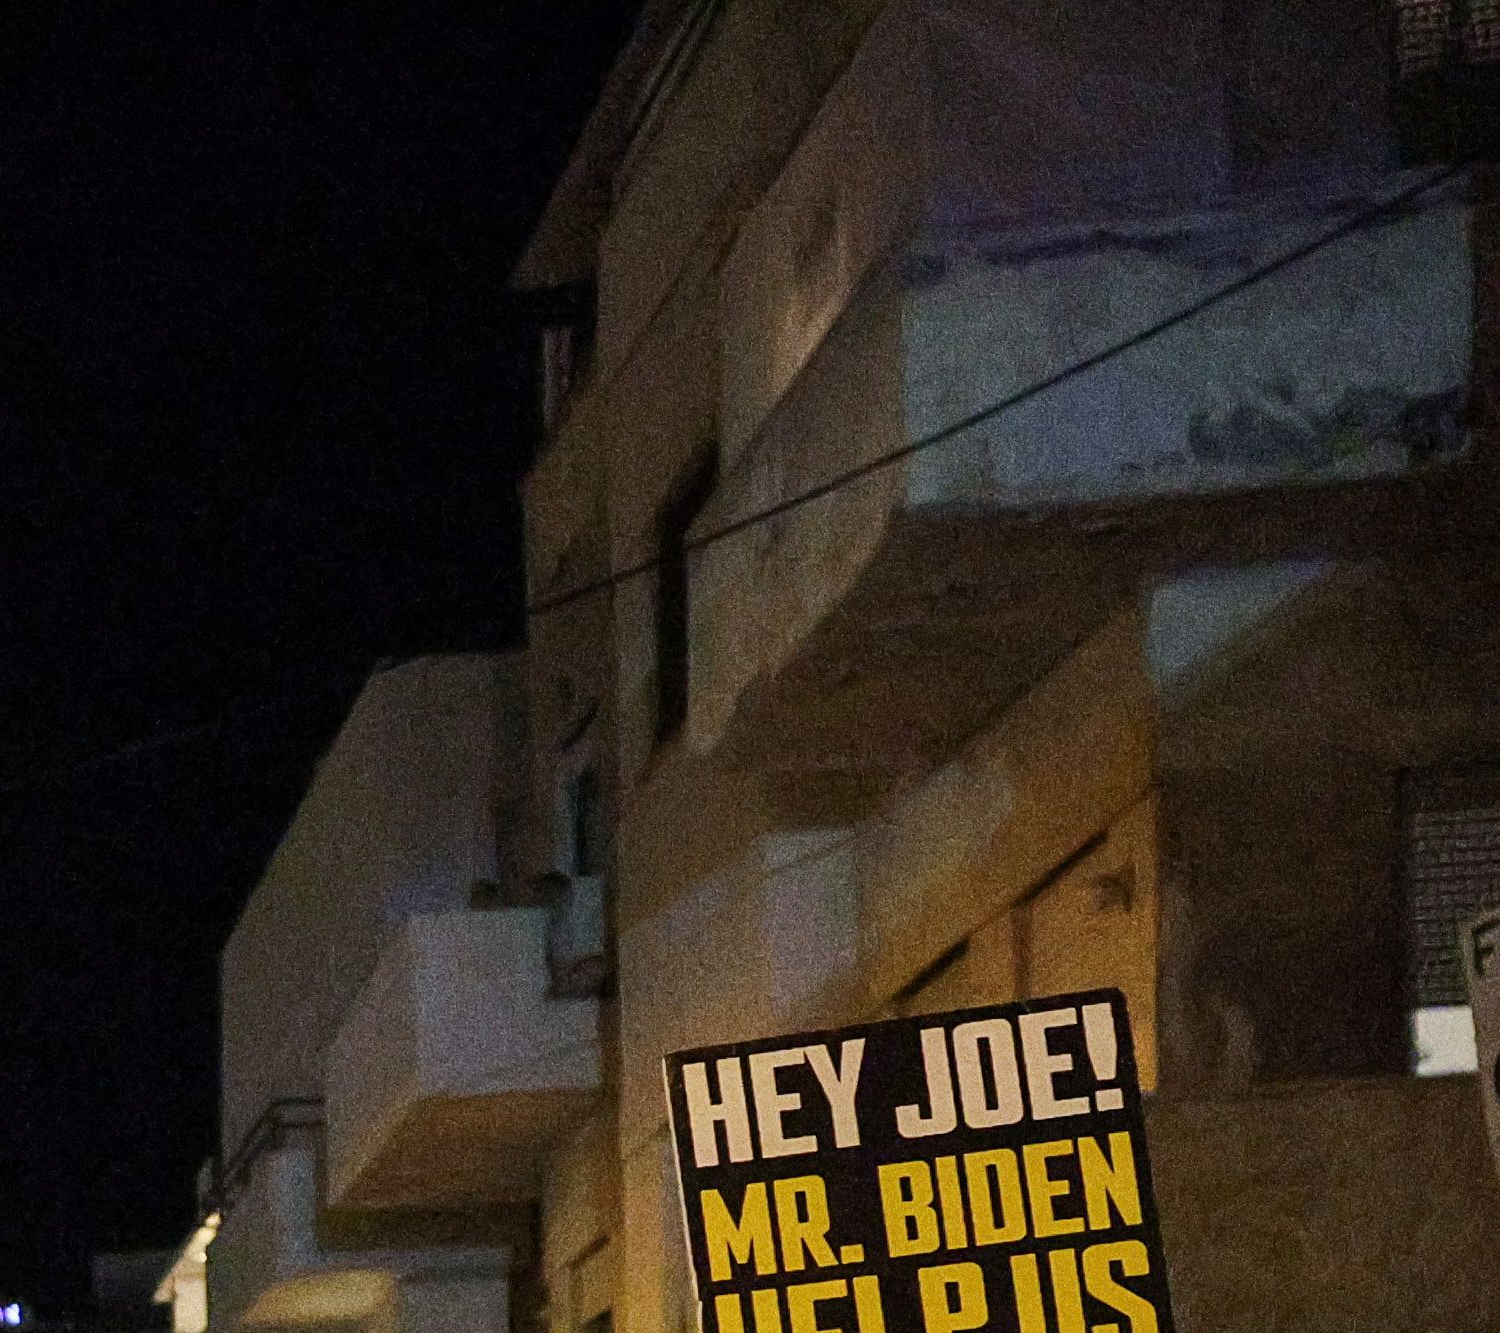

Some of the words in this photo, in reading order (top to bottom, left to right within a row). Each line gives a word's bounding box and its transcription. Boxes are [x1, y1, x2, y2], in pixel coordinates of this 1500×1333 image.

[683, 1037, 866, 1168] HEY
[894, 1002, 1125, 1140] JOE!
[699, 1174, 864, 1282] MR.
[877, 1130, 1145, 1258] BIDEN
